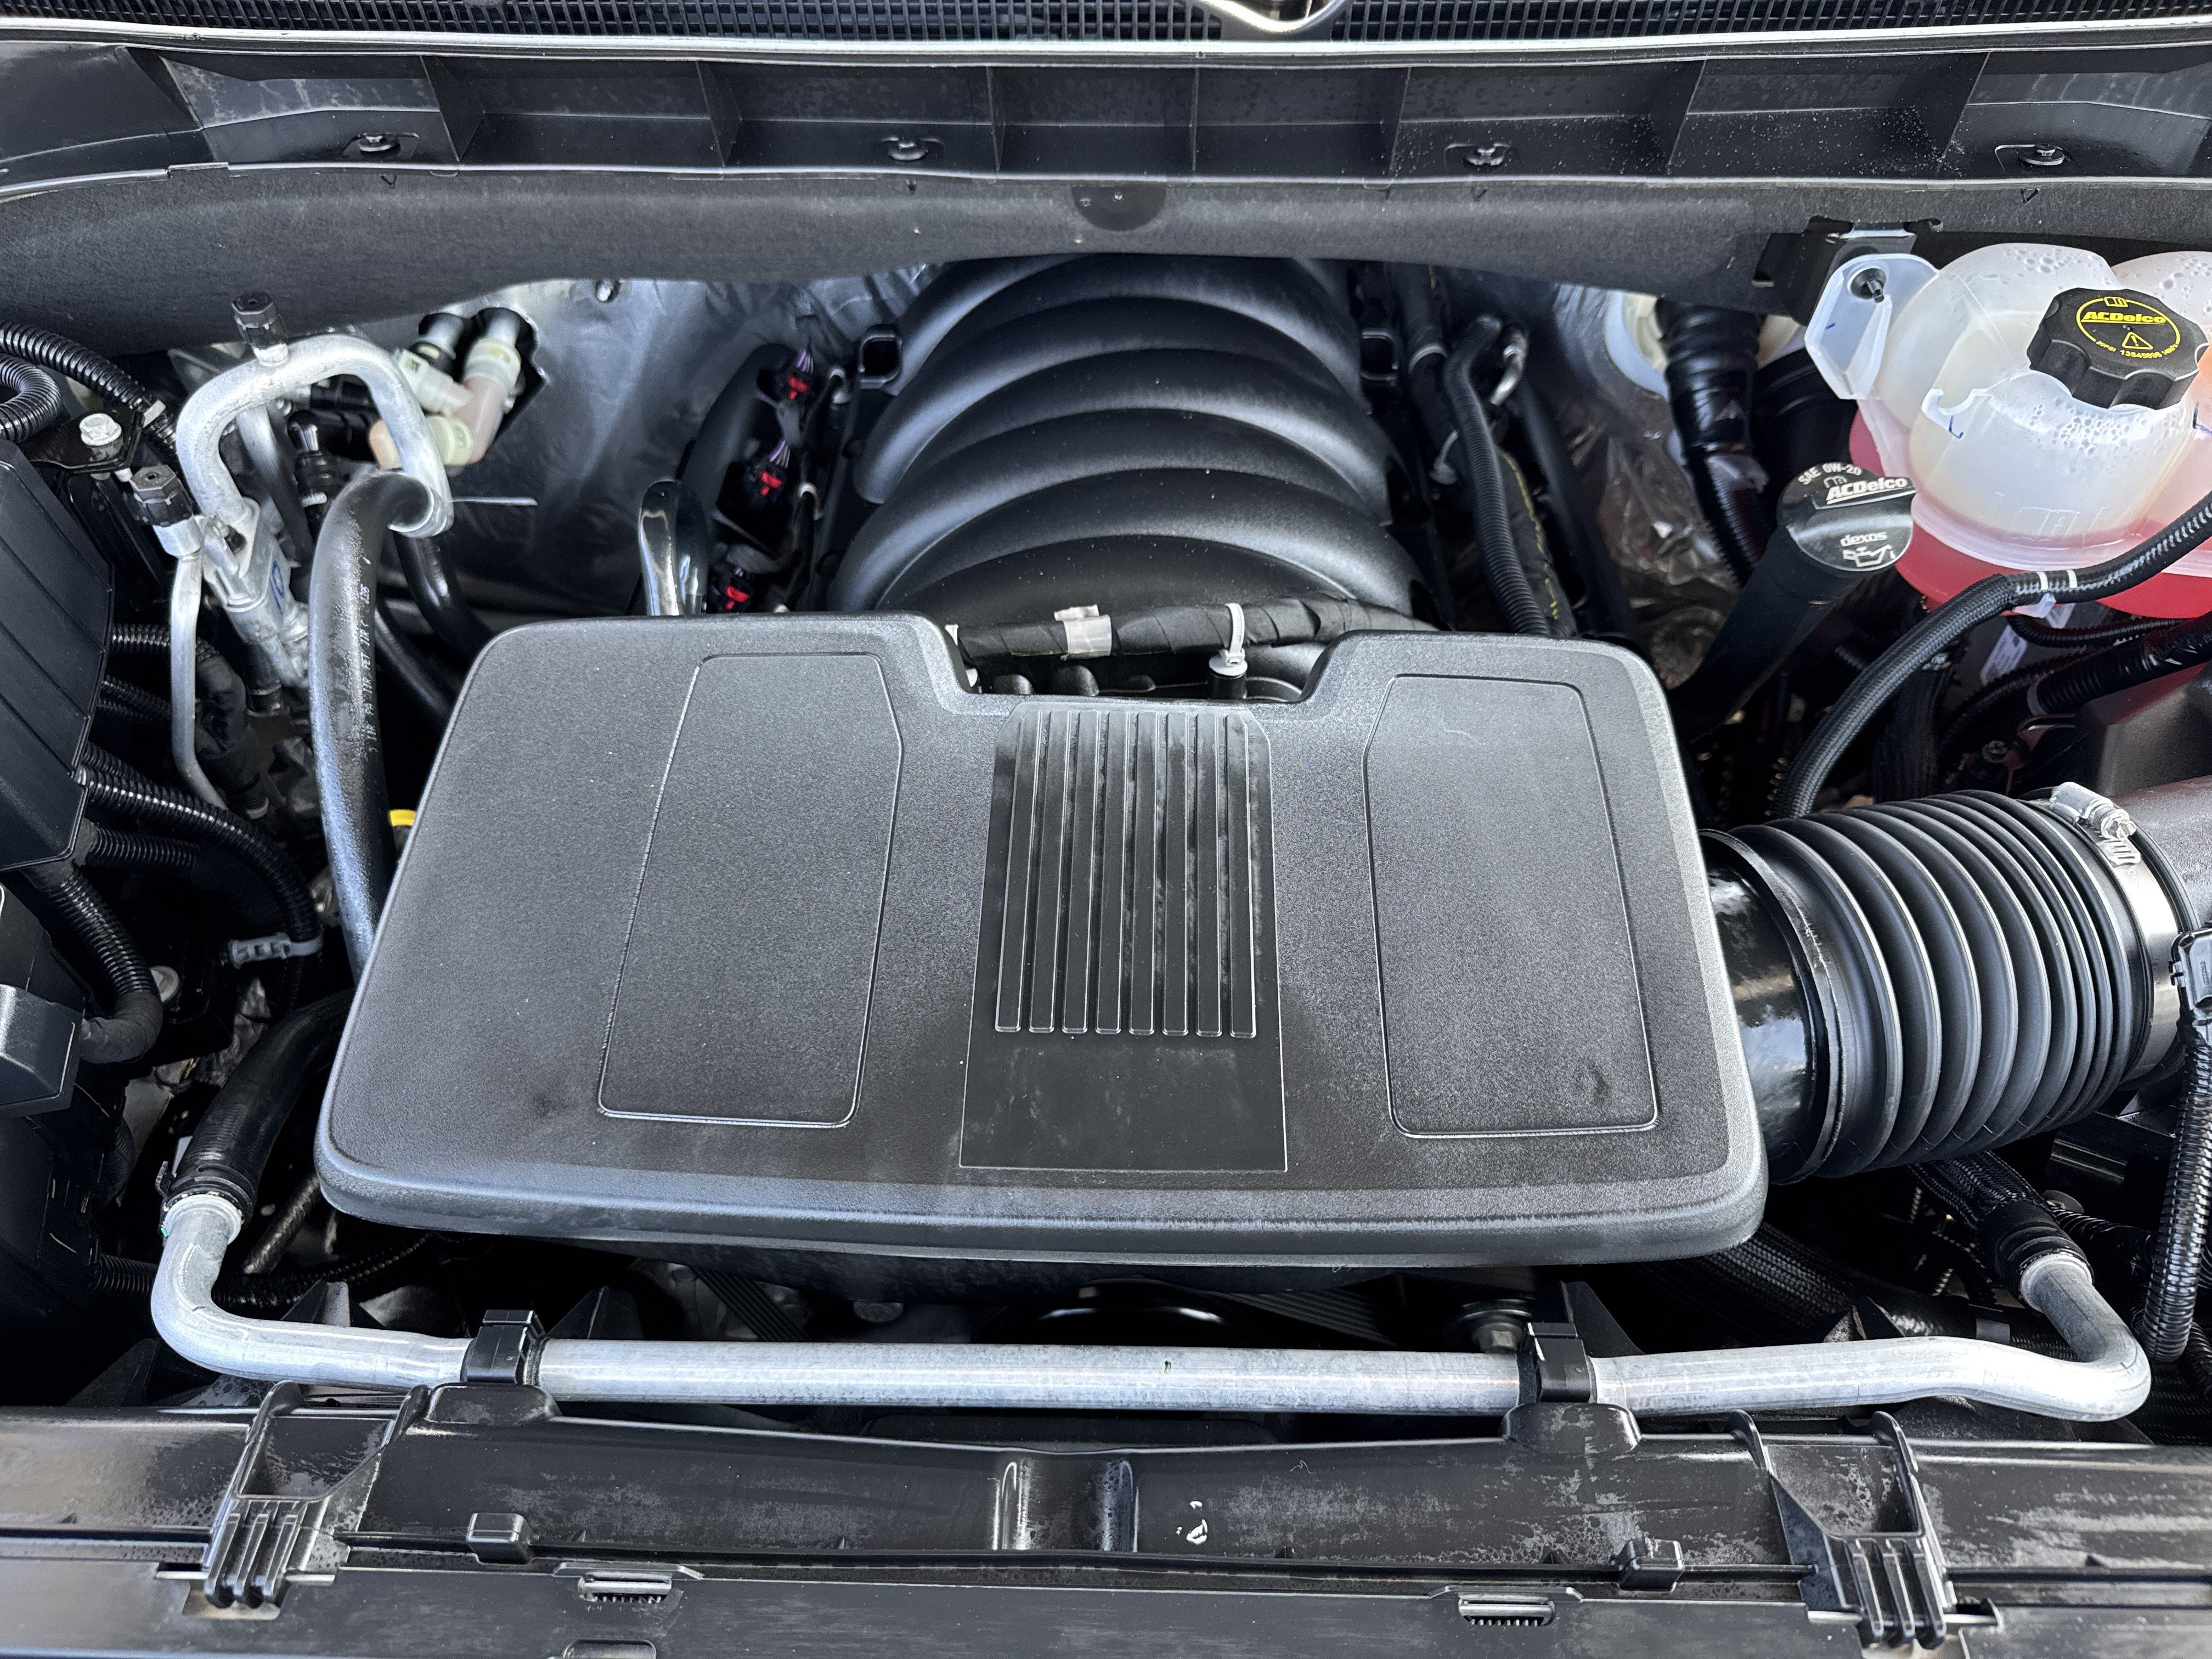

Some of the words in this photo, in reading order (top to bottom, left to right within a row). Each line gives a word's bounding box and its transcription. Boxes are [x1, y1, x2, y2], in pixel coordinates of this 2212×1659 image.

[2083, 311, 2166, 324] ACDelco
[1798, 466, 1821, 485] SAE
[1822, 462, 1862, 476] 0W-20
[1826, 478, 1908, 501] ACDelco
[1840, 532, 1887, 547] dexos
